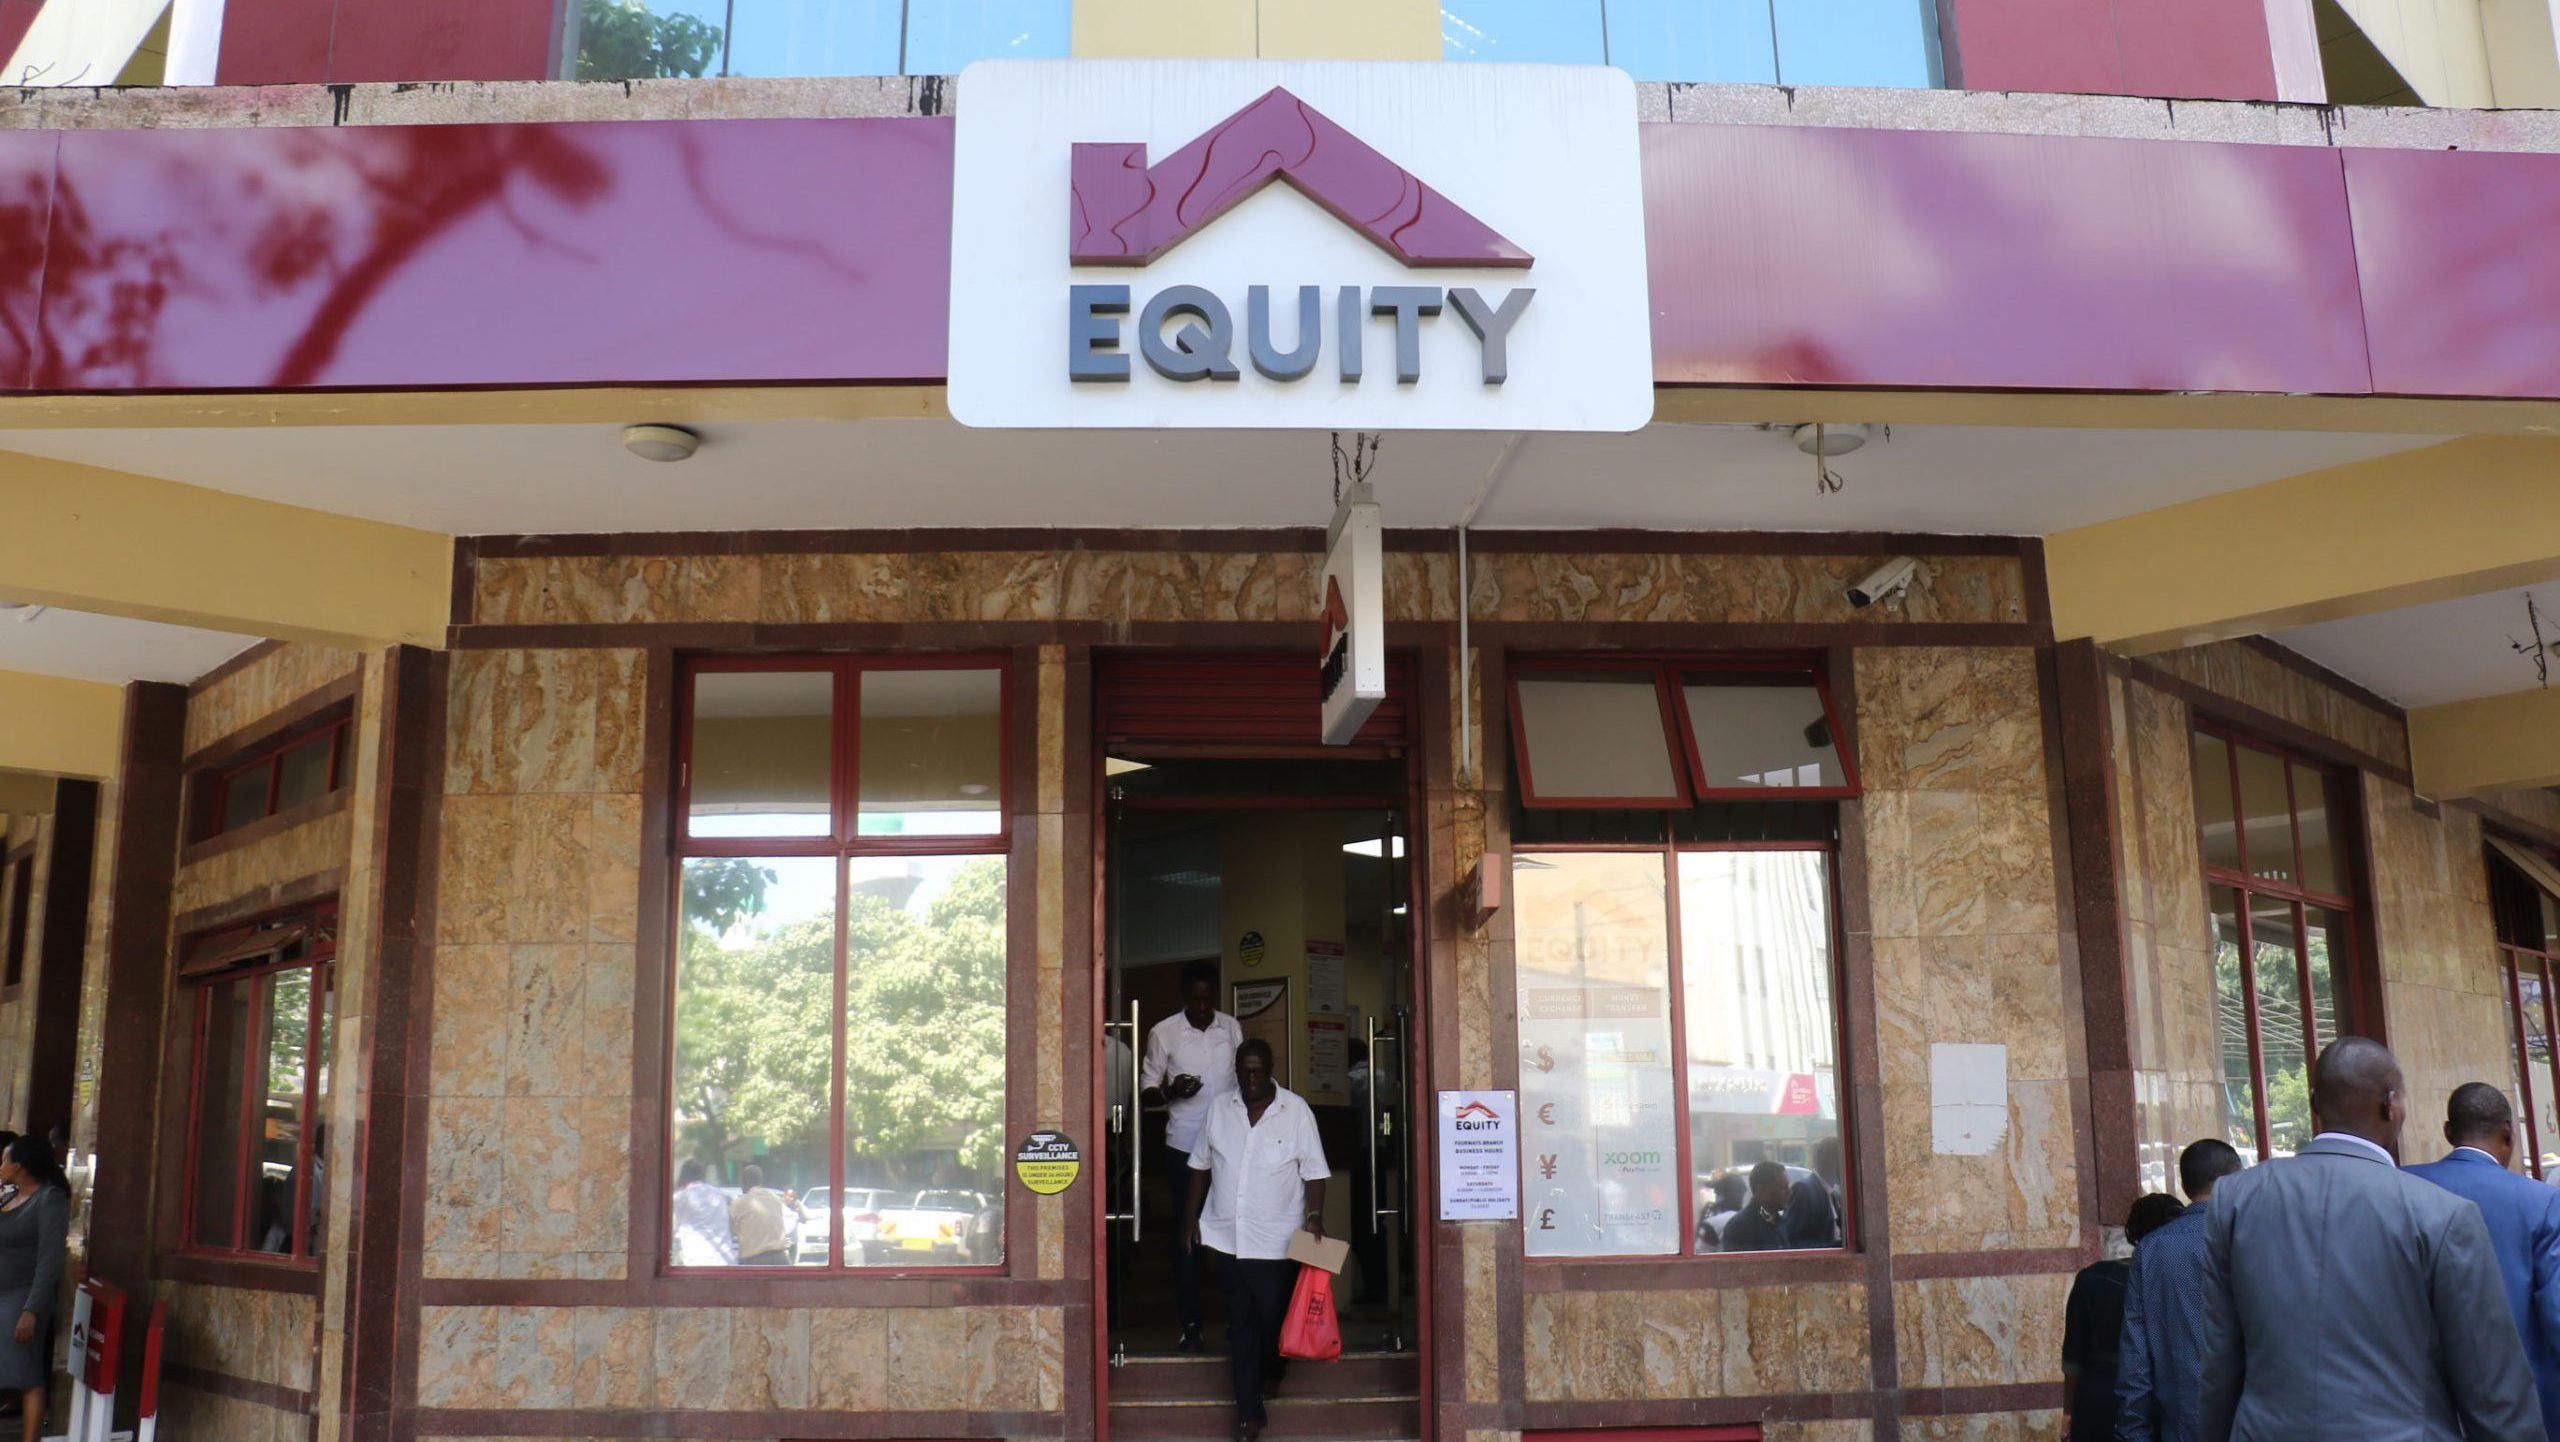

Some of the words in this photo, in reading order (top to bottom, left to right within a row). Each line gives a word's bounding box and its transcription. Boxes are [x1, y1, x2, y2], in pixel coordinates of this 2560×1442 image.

[1070, 284, 1536, 385] EQUITY
[1527, 936, 1654, 962] EQUITY
[1456, 1120, 1501, 1130] EQUITY
[1047, 1143, 1069, 1151] CCTV
[1017, 1151, 1079, 1160] SURVEILLANCE
[1604, 1151, 1660, 1165] xoom
